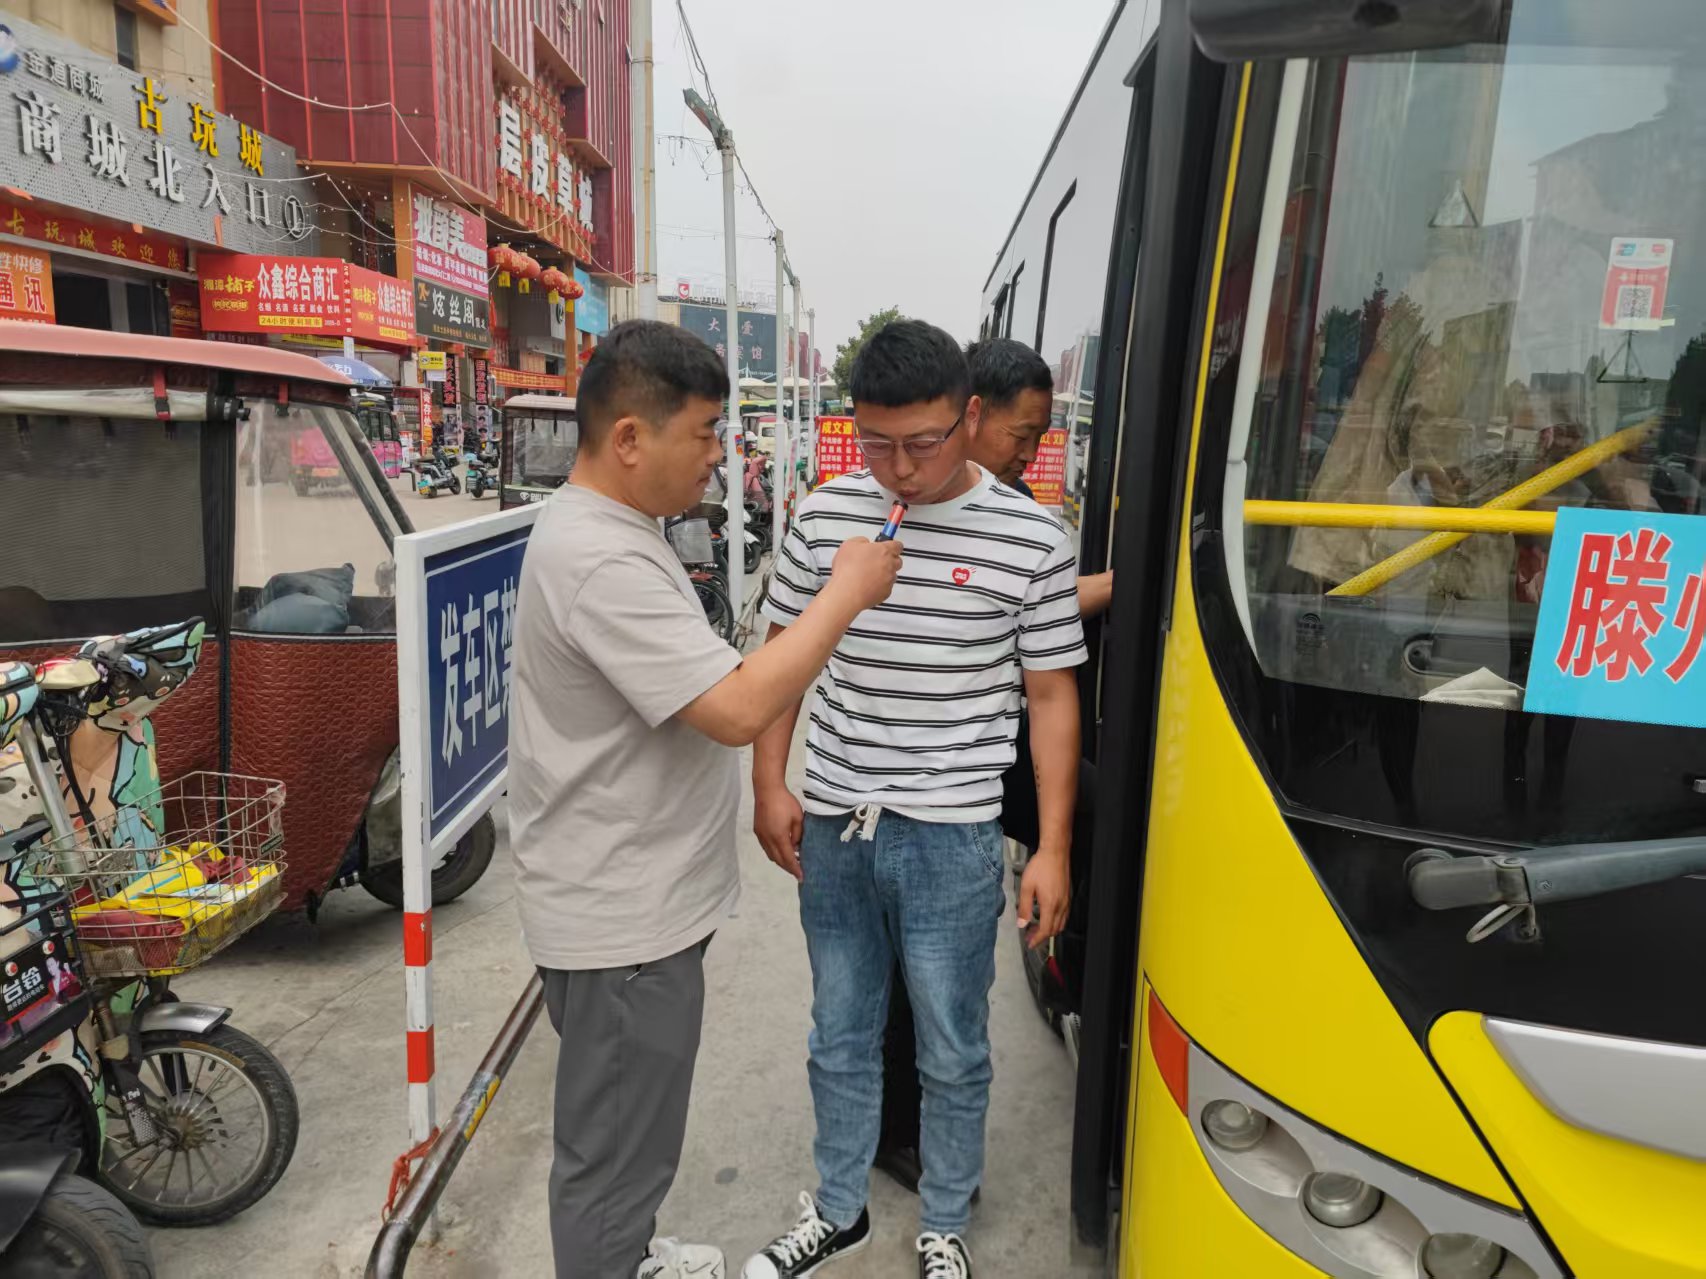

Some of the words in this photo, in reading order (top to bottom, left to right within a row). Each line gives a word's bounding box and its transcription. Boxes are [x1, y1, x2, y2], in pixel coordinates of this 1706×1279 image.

[27, 51, 104, 108] 金道商城
[137, 76, 264, 177] 古玩城
[5, 208, 180, 272] 古玩城欢迎您
[258, 262, 340, 302] 众鑫综合商汇
[3, 966, 42, 1005] 台铃
